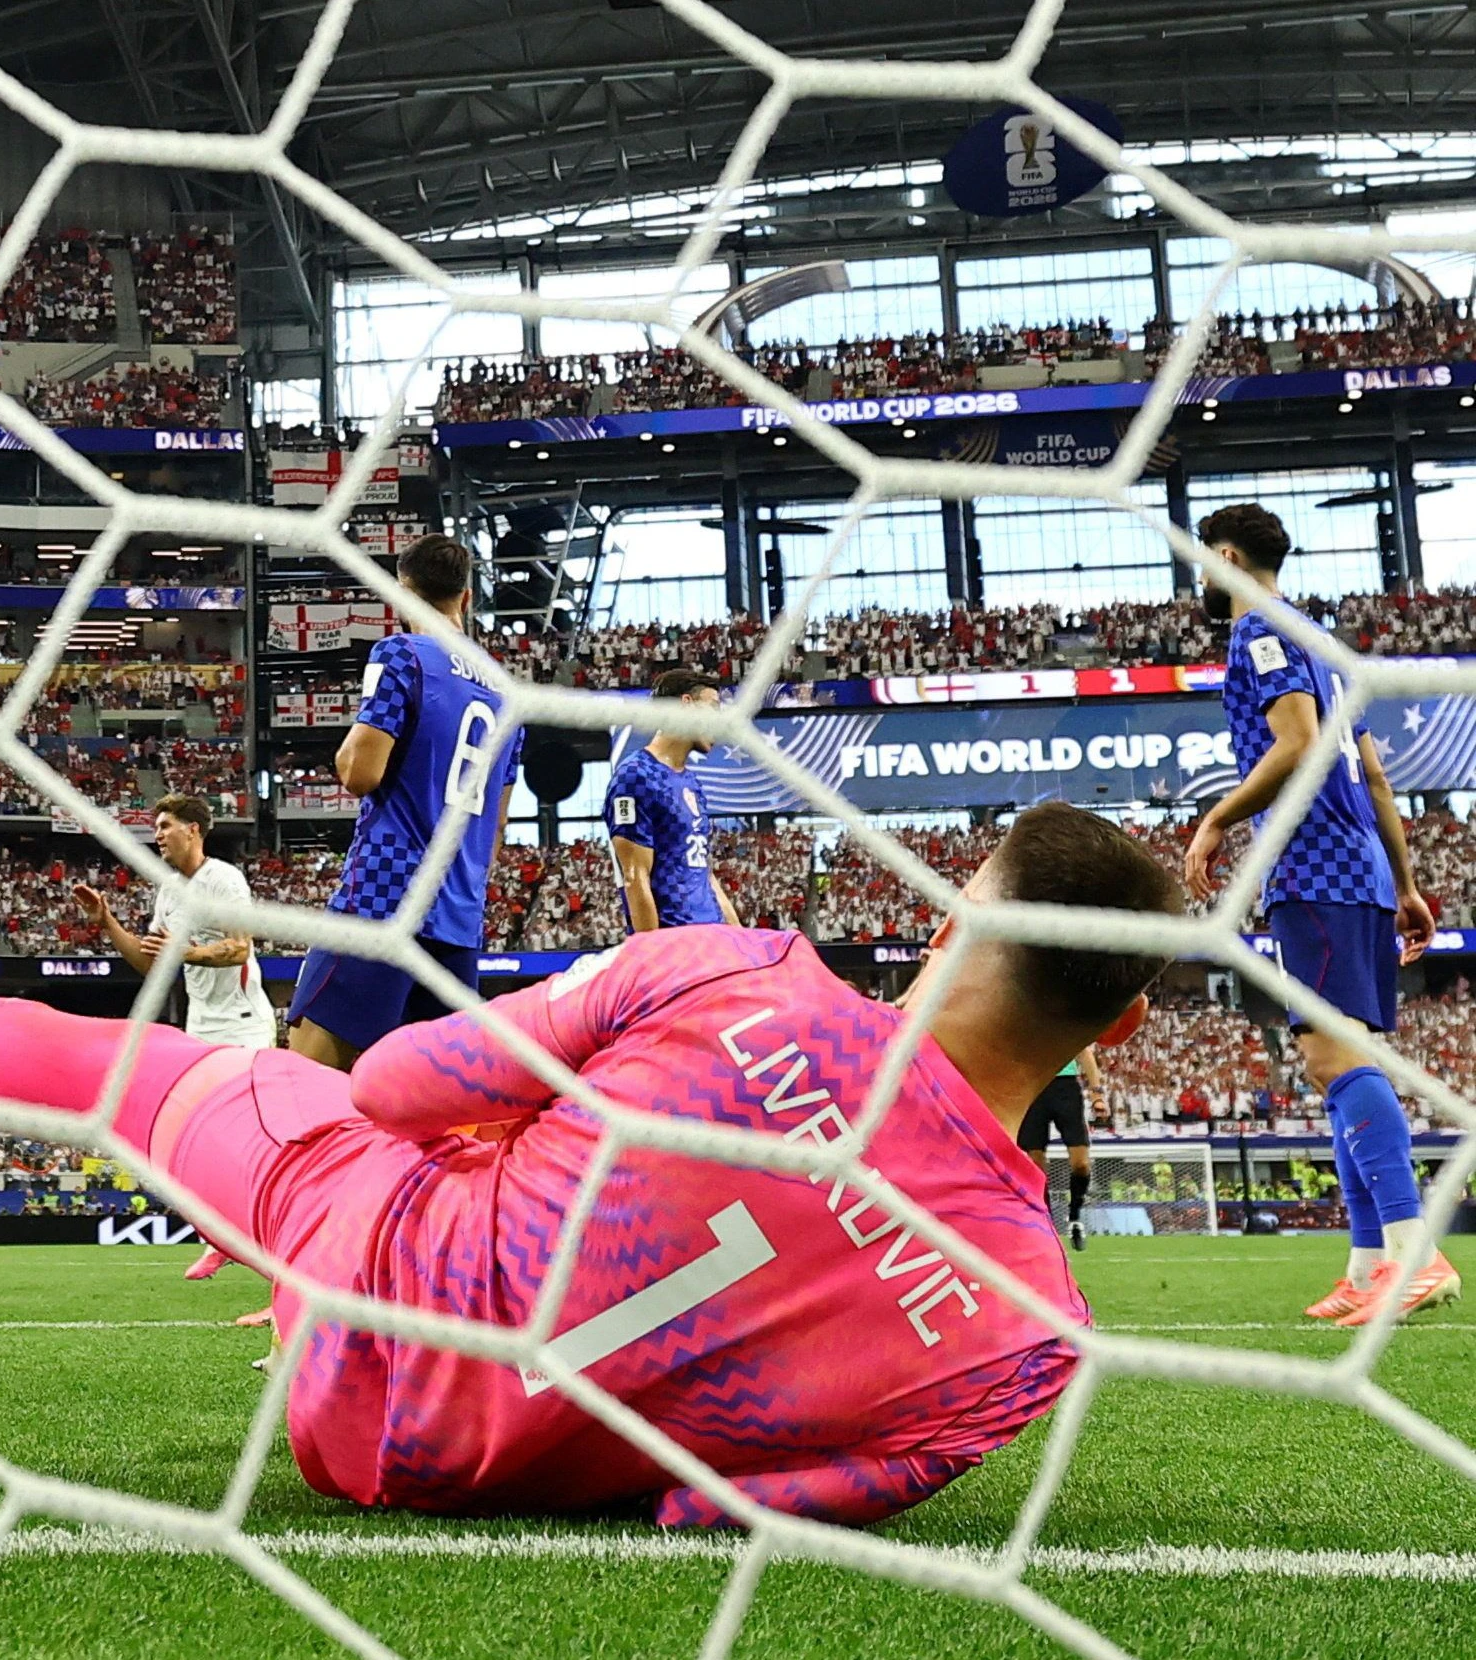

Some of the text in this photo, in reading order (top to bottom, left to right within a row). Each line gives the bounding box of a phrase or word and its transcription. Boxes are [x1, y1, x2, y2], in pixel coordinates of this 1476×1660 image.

[1021, 171, 1044, 181] FIFA
[1008, 186, 1057, 197] WORLD CUP
[1008, 193, 1057, 207] 2026
[1344, 365, 1452, 390] DALLAS
[741, 392, 1018, 428] FIFA WORLD CUP 2026
[155, 431, 244, 450] DALLAS
[1037, 434, 1076, 448] FIFA
[1006, 446, 1111, 465] WORLD CUP
[366, 492, 397, 500] PROUD
[315, 630, 341, 639] FEAR
[317, 639, 339, 648] NOT
[1022, 669, 1136, 693] 1 1
[840, 743, 929, 778] FIFA
[930, 737, 1082, 776] WORLD
[1086, 733, 1172, 769] CUP
[42, 961, 111, 976] DALLAS
[518, 1199, 779, 1399] 1
